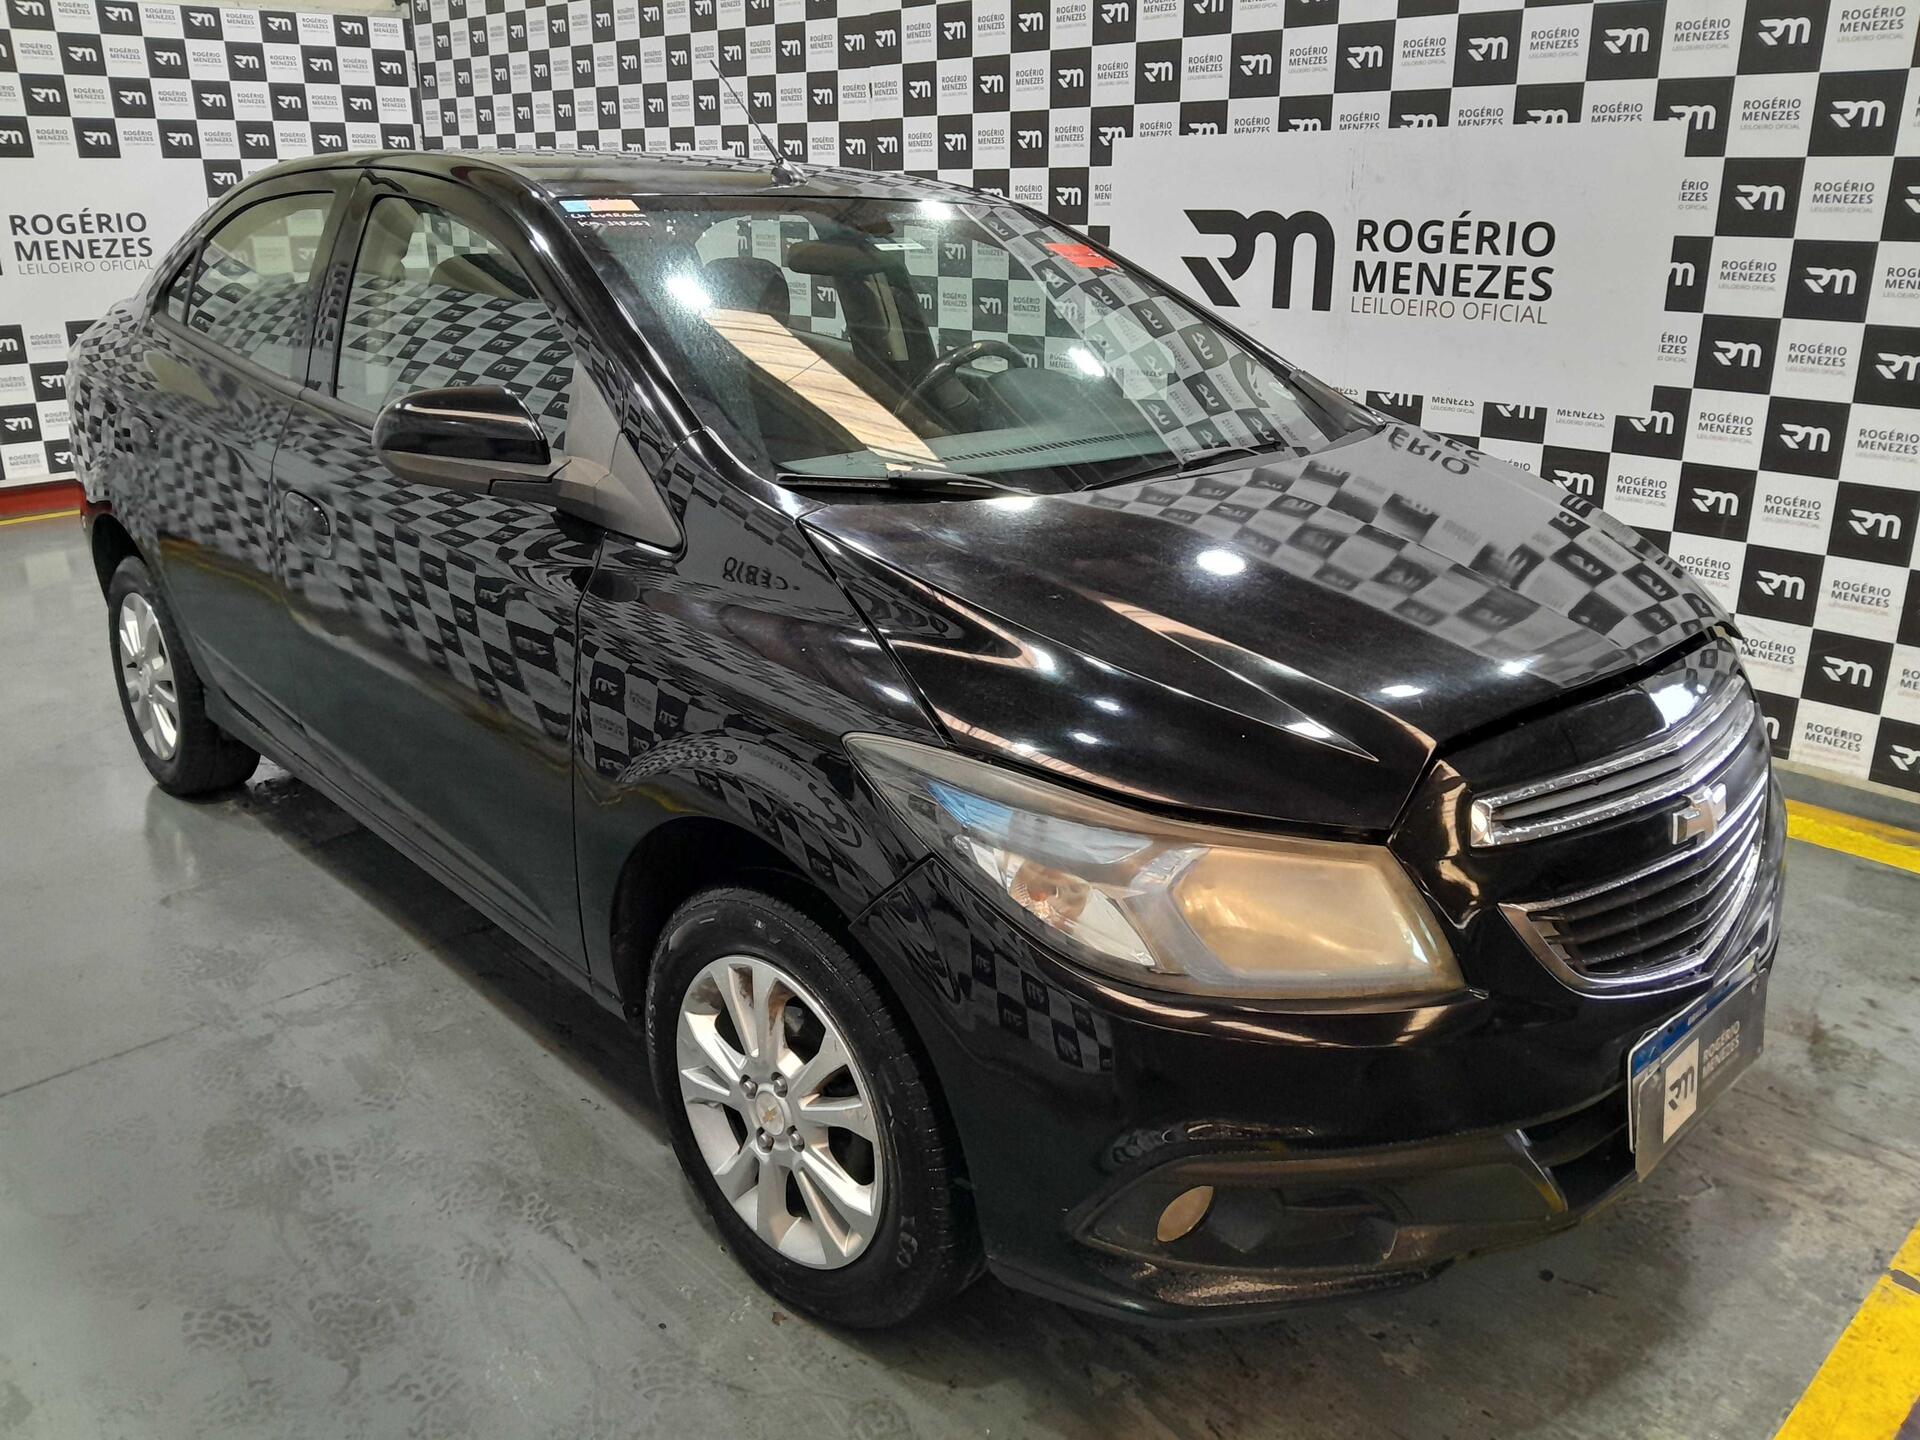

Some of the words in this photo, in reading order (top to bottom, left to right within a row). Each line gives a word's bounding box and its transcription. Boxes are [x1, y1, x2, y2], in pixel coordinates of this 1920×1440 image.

[1842, 6, 1906, 20] ROGÉRIO
[1675, 17, 1730, 31] ROGÉRIO
[1840, 19, 1904, 32] MENEZES
[1531, 27, 1579, 40] ROGÉRIO
[1674, 30, 1729, 42] MENEZES
[1403, 36, 1446, 48] ROGÉRIO
[1530, 39, 1578, 50] MENEZES
[1290, 46, 1328, 56] ROGÉRIO
[1402, 47, 1446, 58] MENEZES
[1188, 54, 1222, 64] ROGÉRIO
[1289, 56, 1328, 66] MENEZES
[1098, 61, 1128, 71] ROGÉRIO
[1188, 63, 1223, 73] MENEZES
[1097, 70, 1128, 80] MENEZES
[1592, 102, 1643, 113] ROGÉRIO
[1743, 97, 1801, 110] ROGÉRIO
[1340, 111, 1380, 122] ROGÉRIO
[1458, 106, 1504, 118] ROGÉRIO
[1742, 110, 1800, 121] MENEZES
[1681, 179, 1709, 190] ÉRIO
[1814, 180, 1874, 192] ROGÉRIO
[1812, 194, 1873, 204] MENEZES
[9, 208, 147, 235] ROGÉRIO
[1355, 211, 1557, 257] ROGÉRIO
[14, 237, 153, 262] MENEZES
[18, 261, 96, 276] LEILOEIRO
[100, 257, 154, 273] OFICIAL
[1721, 259, 1777, 272] ROGÉRIO
[1352, 260, 1553, 302] MENEZES
[1720, 271, 1776, 283] MENEZES
[1350, 296, 1455, 318] LEILOEIRO
[1462, 301, 1548, 325] OFICIAL
[1661, 332, 1688, 344] ÉRIO
[1789, 343, 1847, 356] ROGÉRIO
[1788, 354, 1846, 367] MENEZES
[1700, 412, 1753, 426] ROGÉRIO
[1698, 422, 1752, 436] MENEZES
[1859, 428, 1920, 444] ROGÉRIO
[1857, 440, 1918, 455] MENEZES
[1617, 475, 1667, 489] ROGÉRIO
[1616, 484, 1666, 499] MENEZES
[1766, 494, 1821, 510] ROGÉRIO
[1764, 505, 1820, 520] MENEZES
[1679, 554, 1731, 572] ROGÉRIO
[1833, 580, 1891, 597] ROGÉRIO
[1831, 590, 1889, 608] MENEZES
[1740, 646, 1794, 664] MENEZES
[1806, 722, 1862, 742] ROGÉRIO
[1804, 732, 1860, 752] MENEZES
